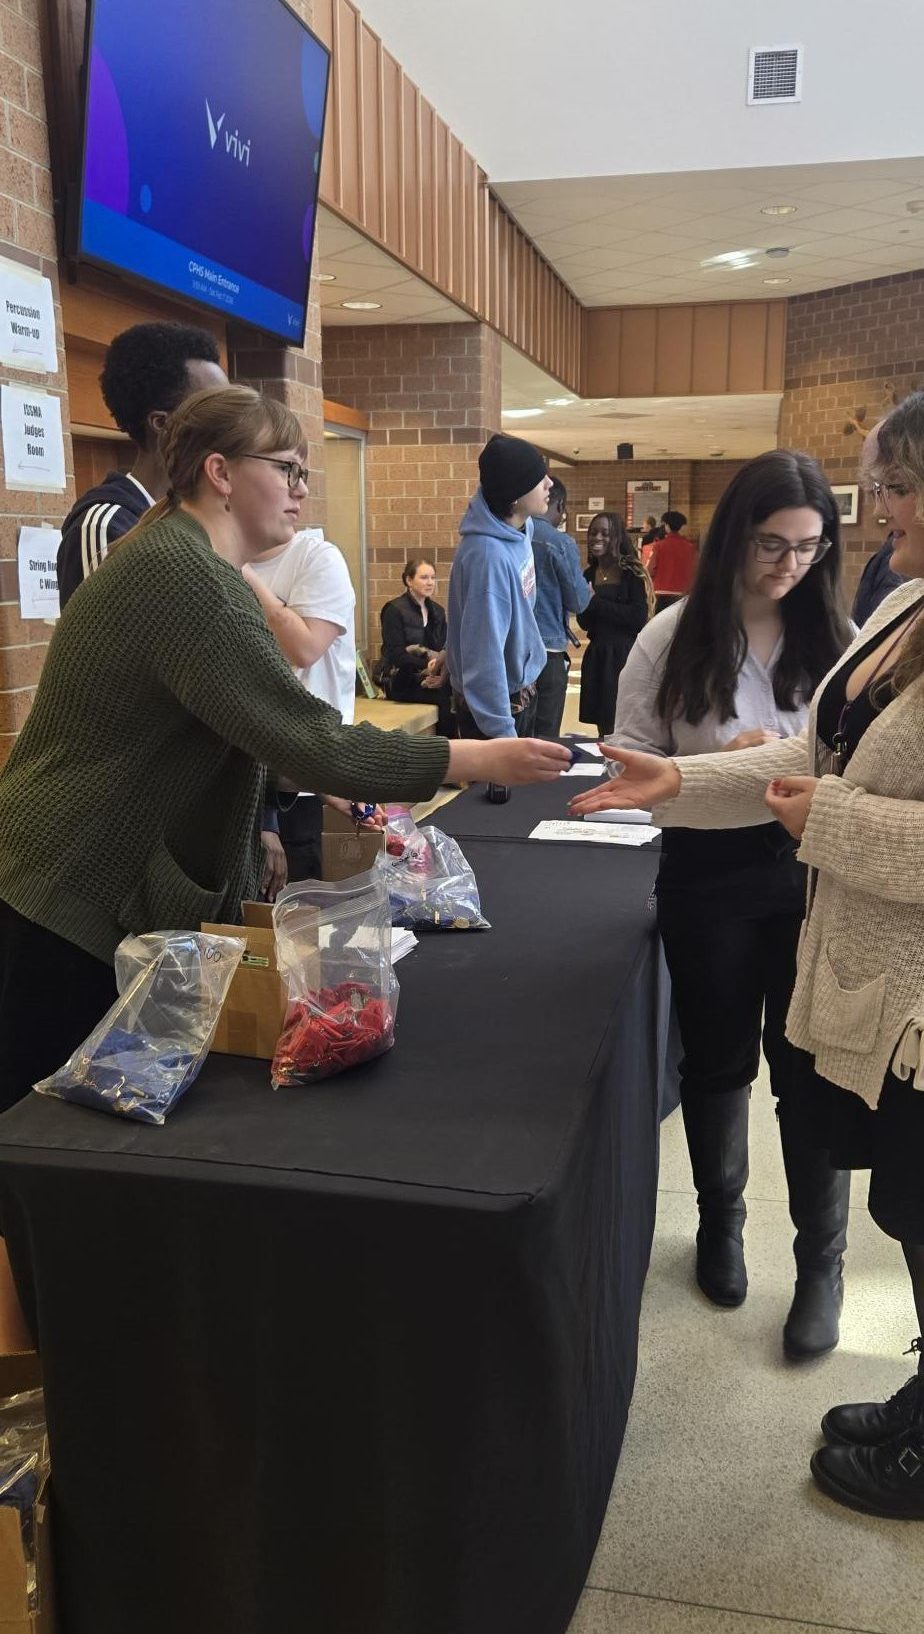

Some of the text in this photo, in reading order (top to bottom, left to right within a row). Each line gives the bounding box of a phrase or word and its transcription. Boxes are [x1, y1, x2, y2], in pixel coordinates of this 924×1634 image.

[225, 129, 251, 168] vivi
[188, 260, 205, 277] CPHS
[204, 268, 218, 282] Main
[217, 274, 240, 294] Entrance
[5, 300, 41, 320] Percussion
[10, 321, 40, 340] Warm-up
[23, 403, 43, 419] ISSMA
[24, 422, 45, 438] Judges
[26, 443, 45, 457] Room
[29, 559, 47, 573] String
[39, 578, 44, 590] C
